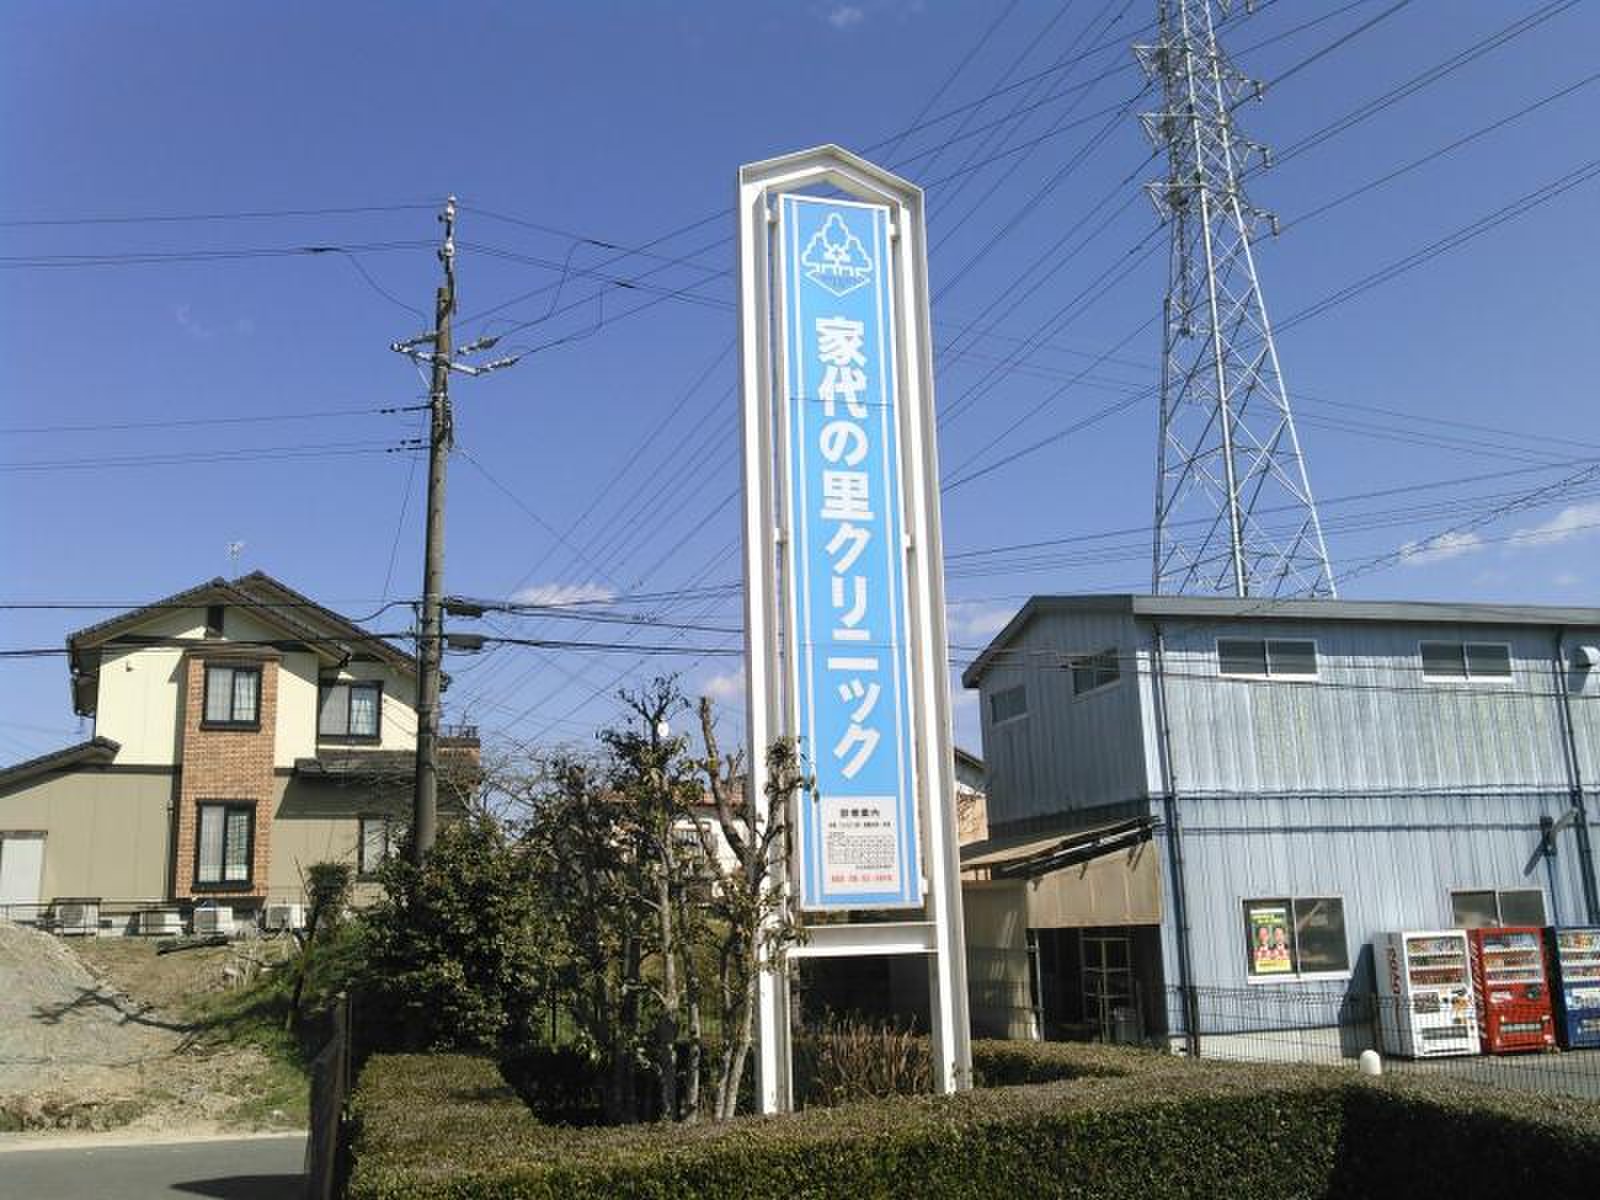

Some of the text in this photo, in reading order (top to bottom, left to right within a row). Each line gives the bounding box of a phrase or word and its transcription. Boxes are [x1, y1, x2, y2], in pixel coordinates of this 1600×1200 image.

[815, 316, 881, 780] 家代の里クリニック
